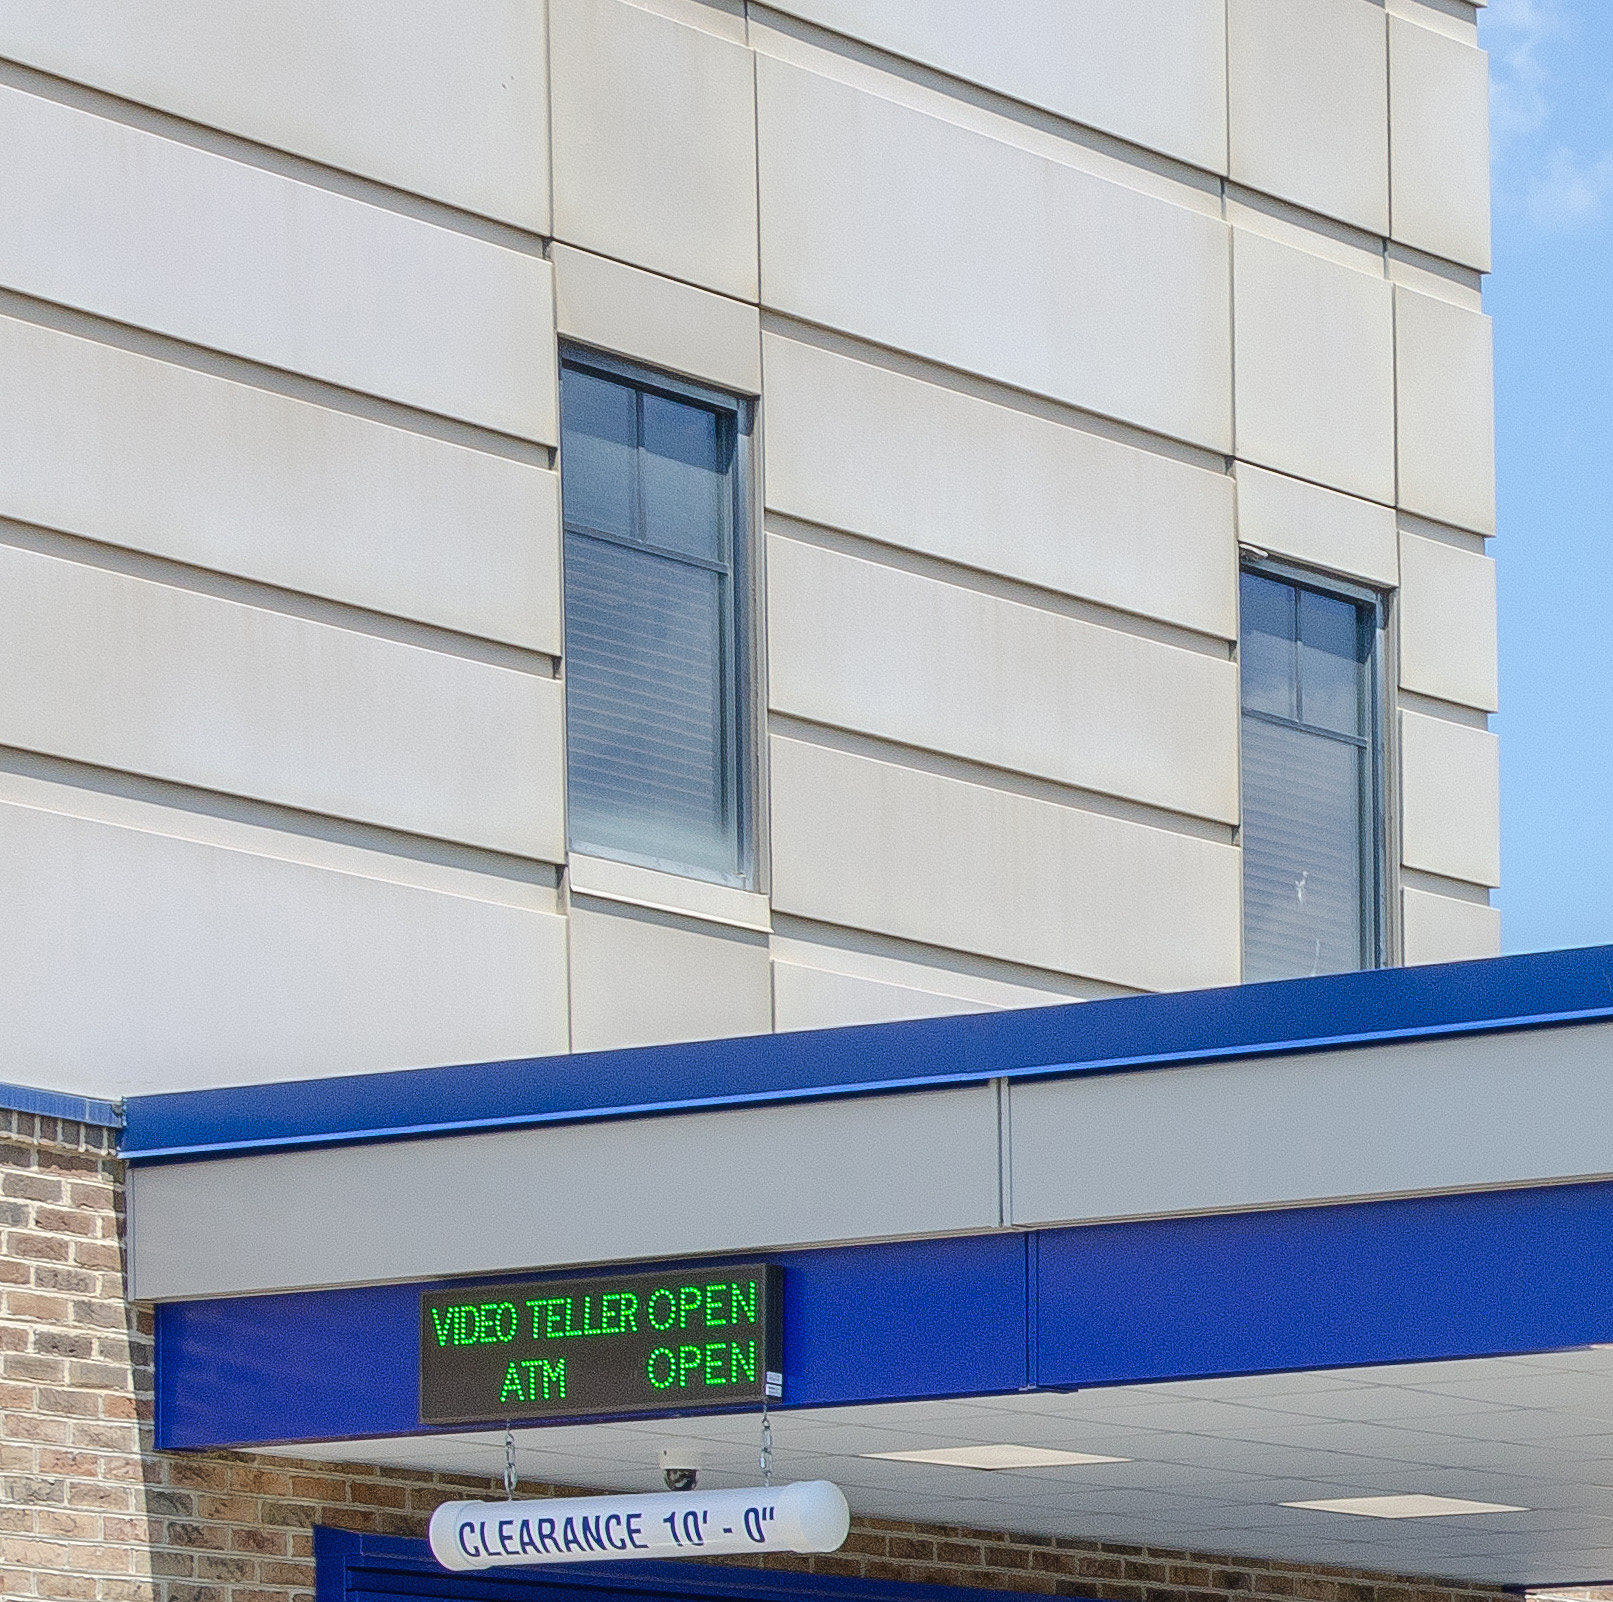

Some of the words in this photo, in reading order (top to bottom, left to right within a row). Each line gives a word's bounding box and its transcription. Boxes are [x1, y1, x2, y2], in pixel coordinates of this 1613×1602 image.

[432, 1301, 518, 1347] VIDEO
[525, 1292, 639, 1340] TELLER
[646, 1281, 758, 1331] OPEN
[499, 1357, 567, 1402] ATM
[646, 1340, 757, 1389] OPEN
[457, 1512, 650, 1558] CLEARANCE
